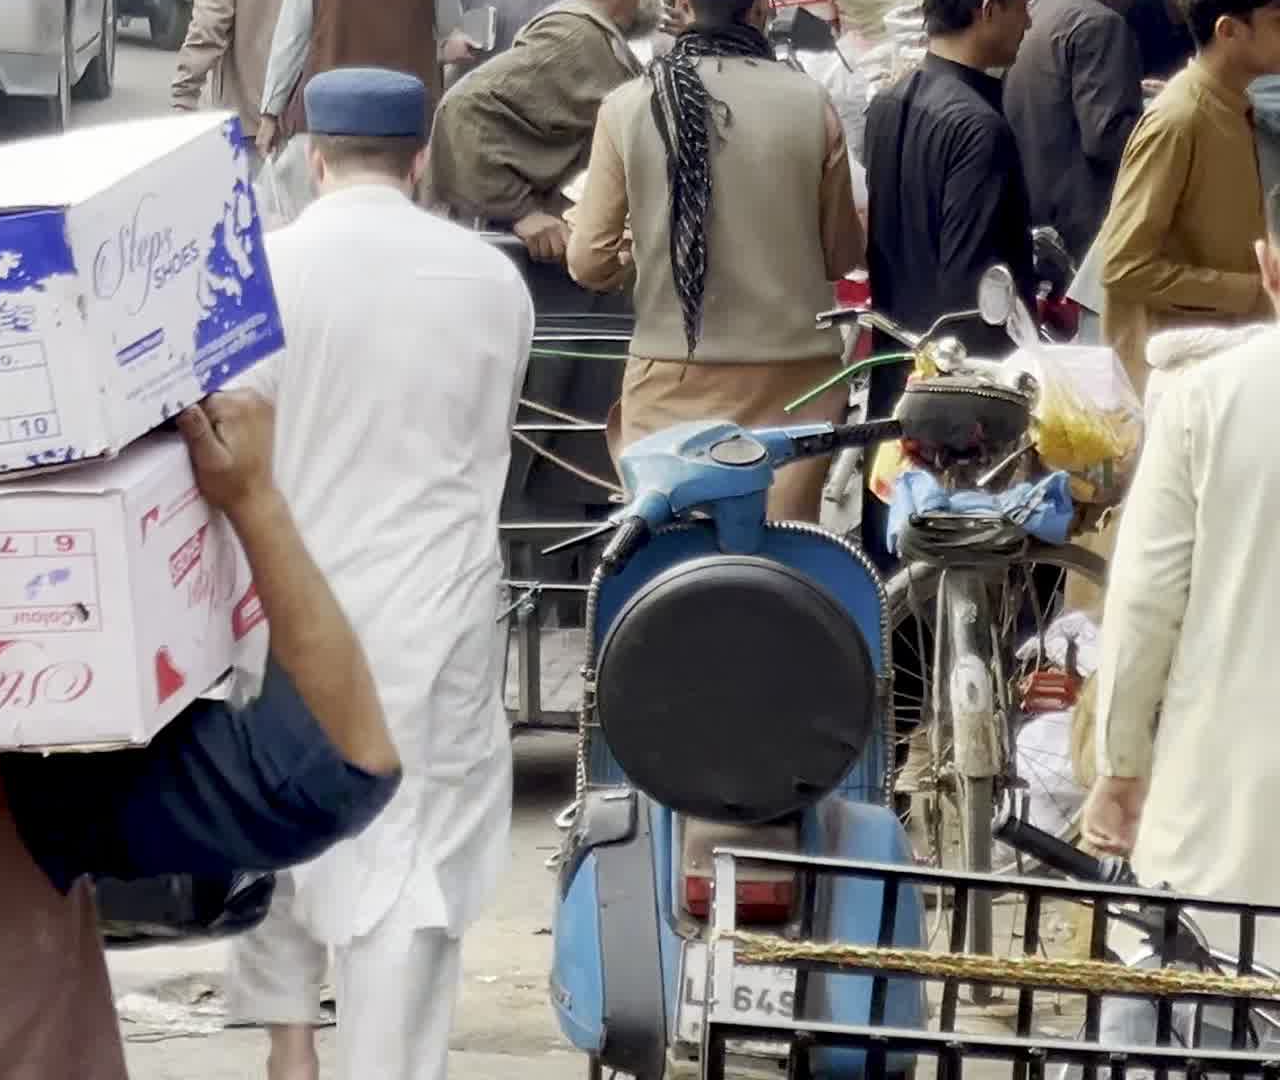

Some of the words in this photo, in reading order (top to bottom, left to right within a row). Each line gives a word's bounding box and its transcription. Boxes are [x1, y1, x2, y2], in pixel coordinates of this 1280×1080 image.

[93, 192, 176, 317] Steps
[153, 238, 202, 290] SHOES
[20, 416, 49, 437] 10
[13, 611, 78, 628] Colour
